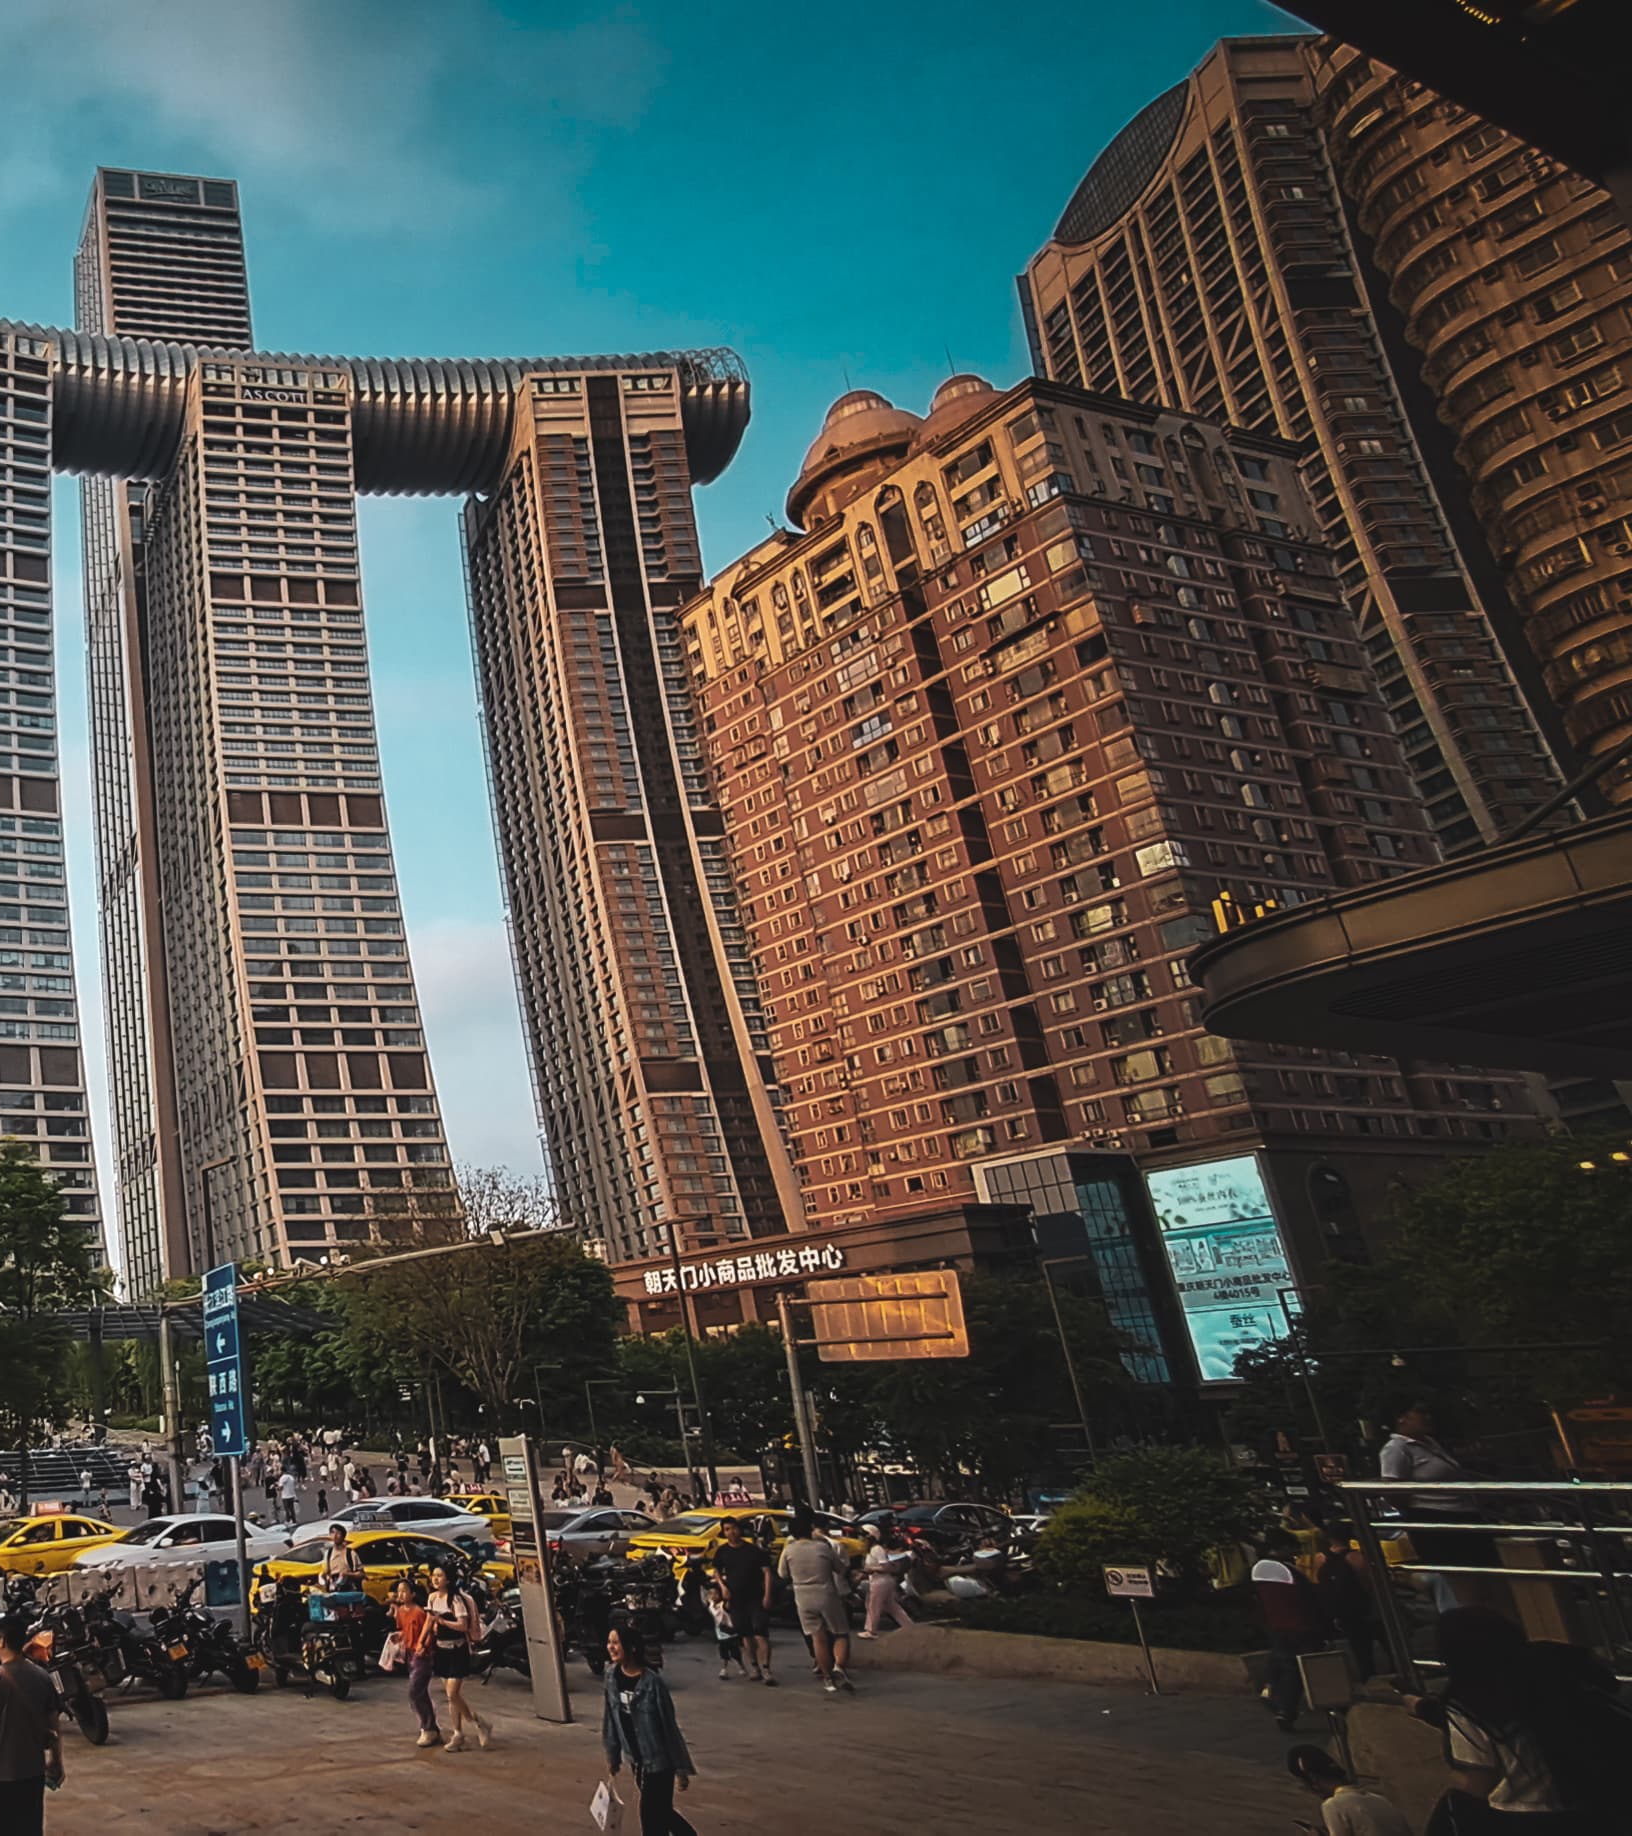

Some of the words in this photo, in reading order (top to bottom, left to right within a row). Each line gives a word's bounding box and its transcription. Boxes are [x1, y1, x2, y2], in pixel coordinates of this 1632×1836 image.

[243, 389, 305, 403] ASCOTT
[643, 1243, 843, 1295] 朝天门小商品批发中心
